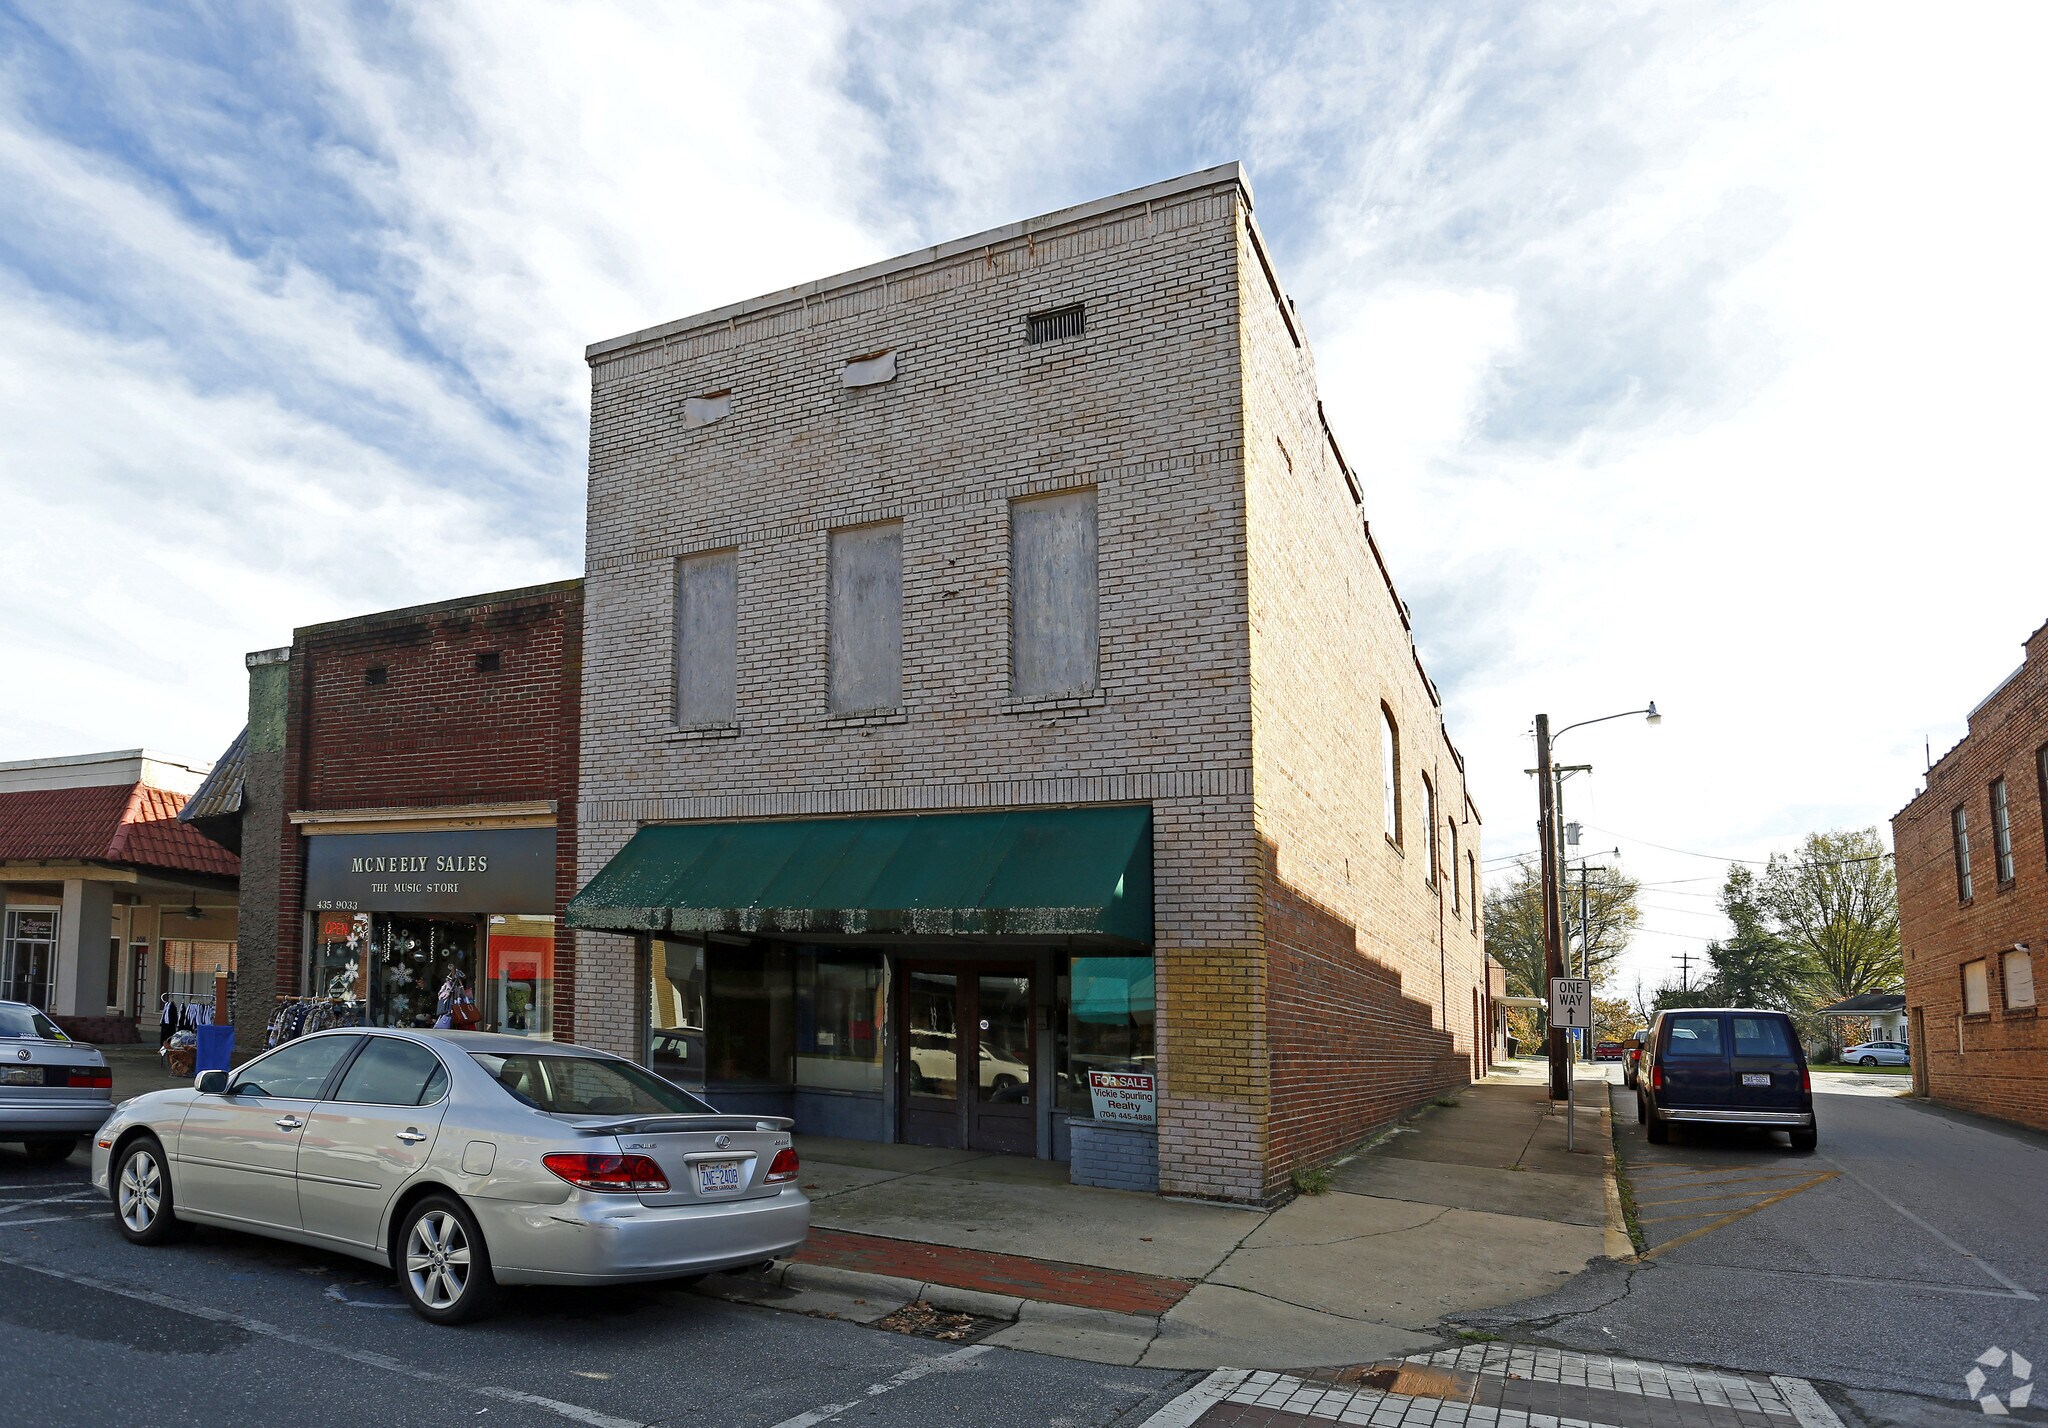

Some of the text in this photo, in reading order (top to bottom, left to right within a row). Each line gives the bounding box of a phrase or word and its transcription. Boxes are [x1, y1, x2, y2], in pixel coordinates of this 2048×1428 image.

[352, 855, 488, 873] MCNEELY SALES
[371, 883, 459, 893] THE MUSIC STORE
[317, 901, 358, 910] 435 9033
[325, 921, 348, 935] OPEN
[1559, 982, 1583, 994] ONE
[1559, 994, 1583, 1006] WAY
[1094, 1075, 1148, 1088] FOR SALE
[1094, 1088, 1153, 1103] Vickie Spurling
[1108, 1100, 1141, 1112] Realty
[1099, 1110, 1117, 1119] (704)
